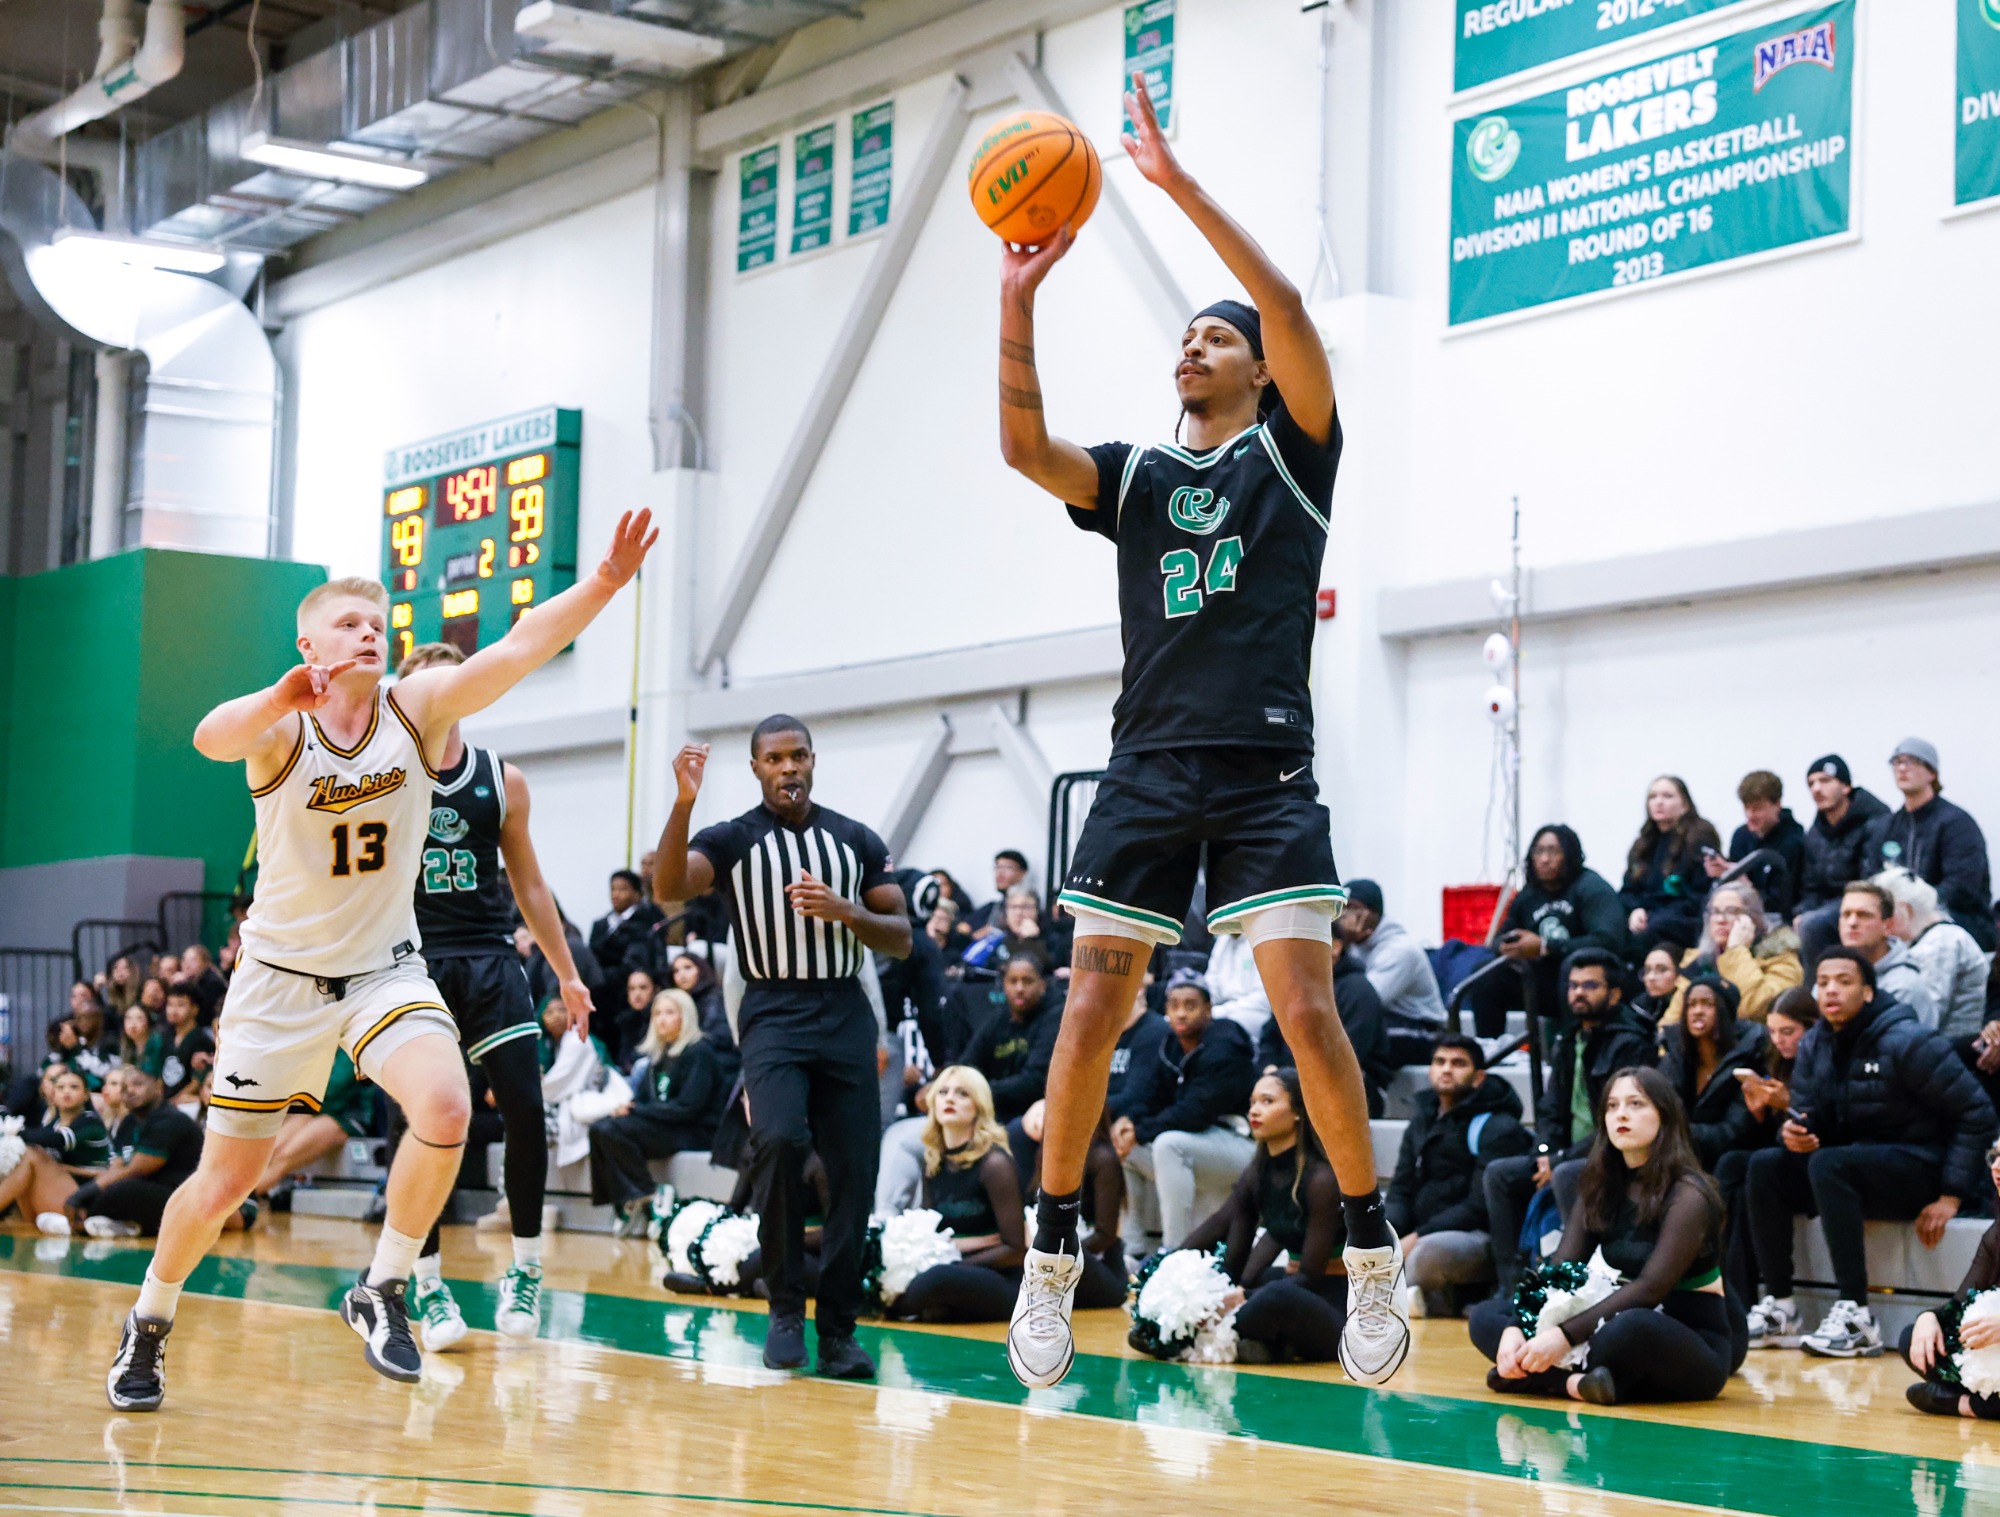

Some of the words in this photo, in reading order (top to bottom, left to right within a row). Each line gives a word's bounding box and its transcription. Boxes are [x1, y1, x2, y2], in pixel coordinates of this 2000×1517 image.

[1463, 0, 1575, 38] REGUL
[1567, 46, 1718, 118] ROOSEVELT
[1756, 24, 1833, 86] NAIA
[1566, 80, 1718, 162] LAKERS
[988, 158, 1028, 205] EVO
[1494, 185, 1545, 220] NAIA
[1547, 154, 1651, 205] WOMEN'S
[1654, 113, 1802, 177] BASKETBALL
[1453, 217, 1541, 262] DIVISION
[1543, 213, 1558, 239] II
[1561, 184, 1666, 234] NATIONAL
[1667, 135, 1846, 206] CHAMPIONSHIP
[1568, 222, 1650, 265] ROUND
[1651, 211, 1684, 243] OF
[1687, 204, 1714, 234] 16
[1612, 251, 1664, 287] 2013
[403, 432, 486, 475] ROOSEVELT
[493, 414, 552, 452] LAKERS
[446, 465, 498, 521] 4:54
[511, 484, 544, 542] 59
[478, 538, 495, 578] 2
[1159, 535, 1244, 619] 24
[306, 767, 406, 808] Huskies
[331, 821, 389, 878] 13
[422, 848, 478, 893] 23
